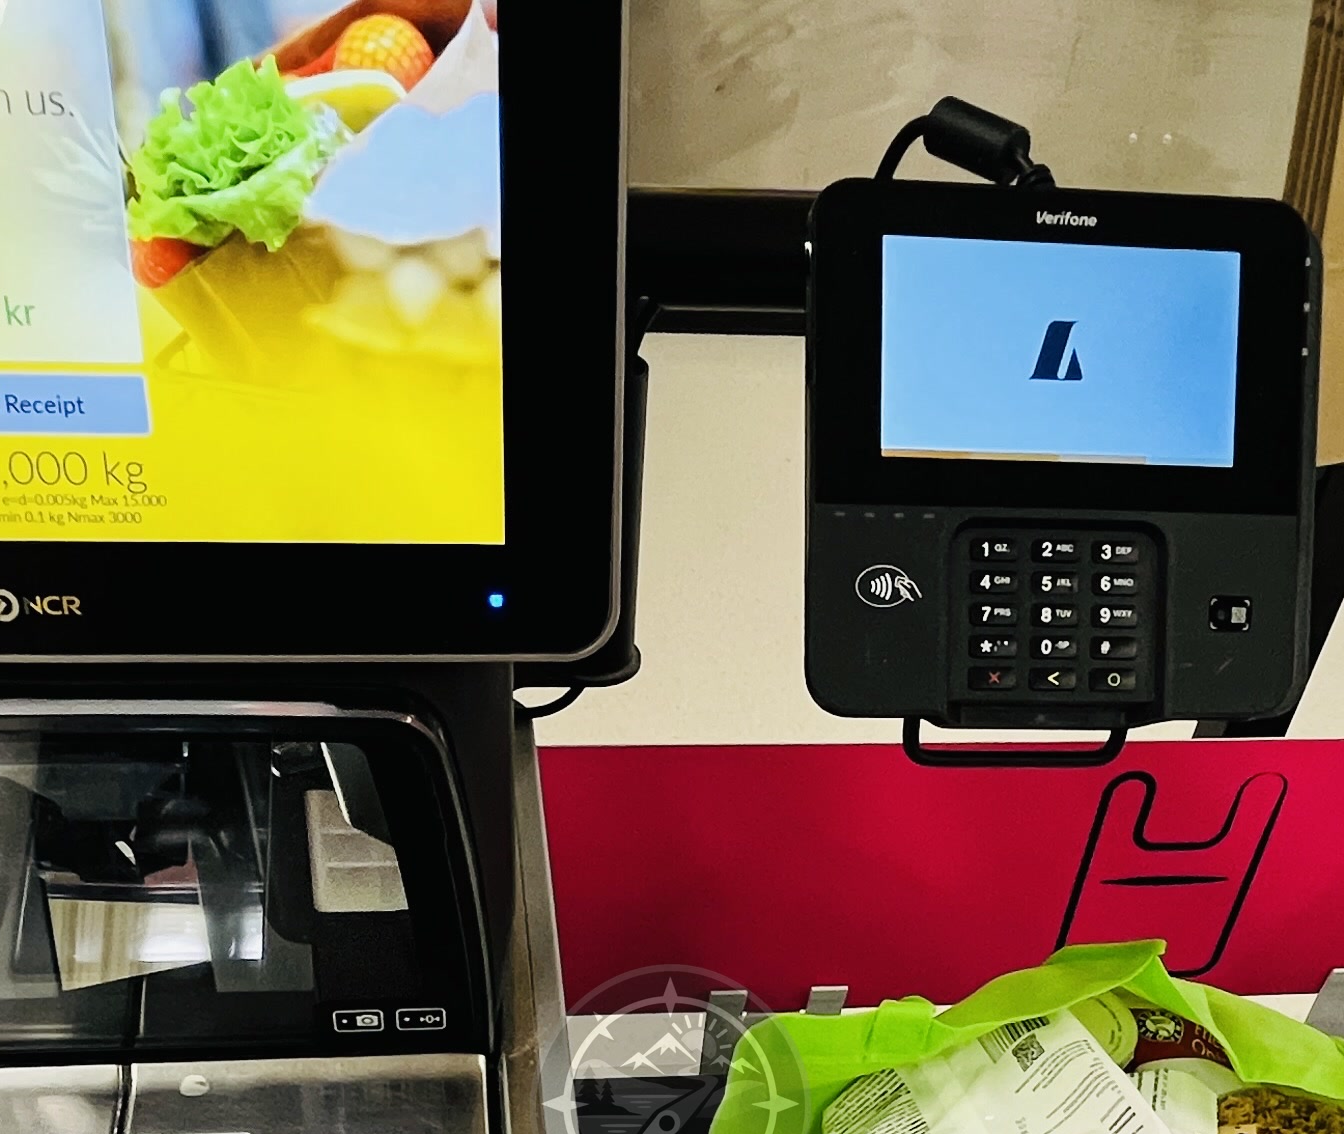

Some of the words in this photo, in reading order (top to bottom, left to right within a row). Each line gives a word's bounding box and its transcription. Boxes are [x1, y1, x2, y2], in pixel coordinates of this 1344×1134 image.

[25, 88, 75, 117] us.
[1036, 211, 1097, 227] Verifone
[3, 295, 36, 326] kr
[5, 393, 85, 418] Receipt
[103, 450, 148, 494] kg
[91, 494, 118, 506] Max
[49, 511, 65, 525] kg
[982, 541, 990, 557] 1
[1041, 541, 1053, 557] 2
[1100, 544, 1112, 560] 3
[980, 574, 991, 590] 4
[1041, 575, 1053, 591] 5
[1100, 575, 1112, 591] 6
[22, 595, 84, 616] NCR
[981, 606, 992, 622] 7
[1040, 607, 1052, 623] 8
[1099, 607, 1111, 623] 9
[1040, 639, 1052, 655] 0
